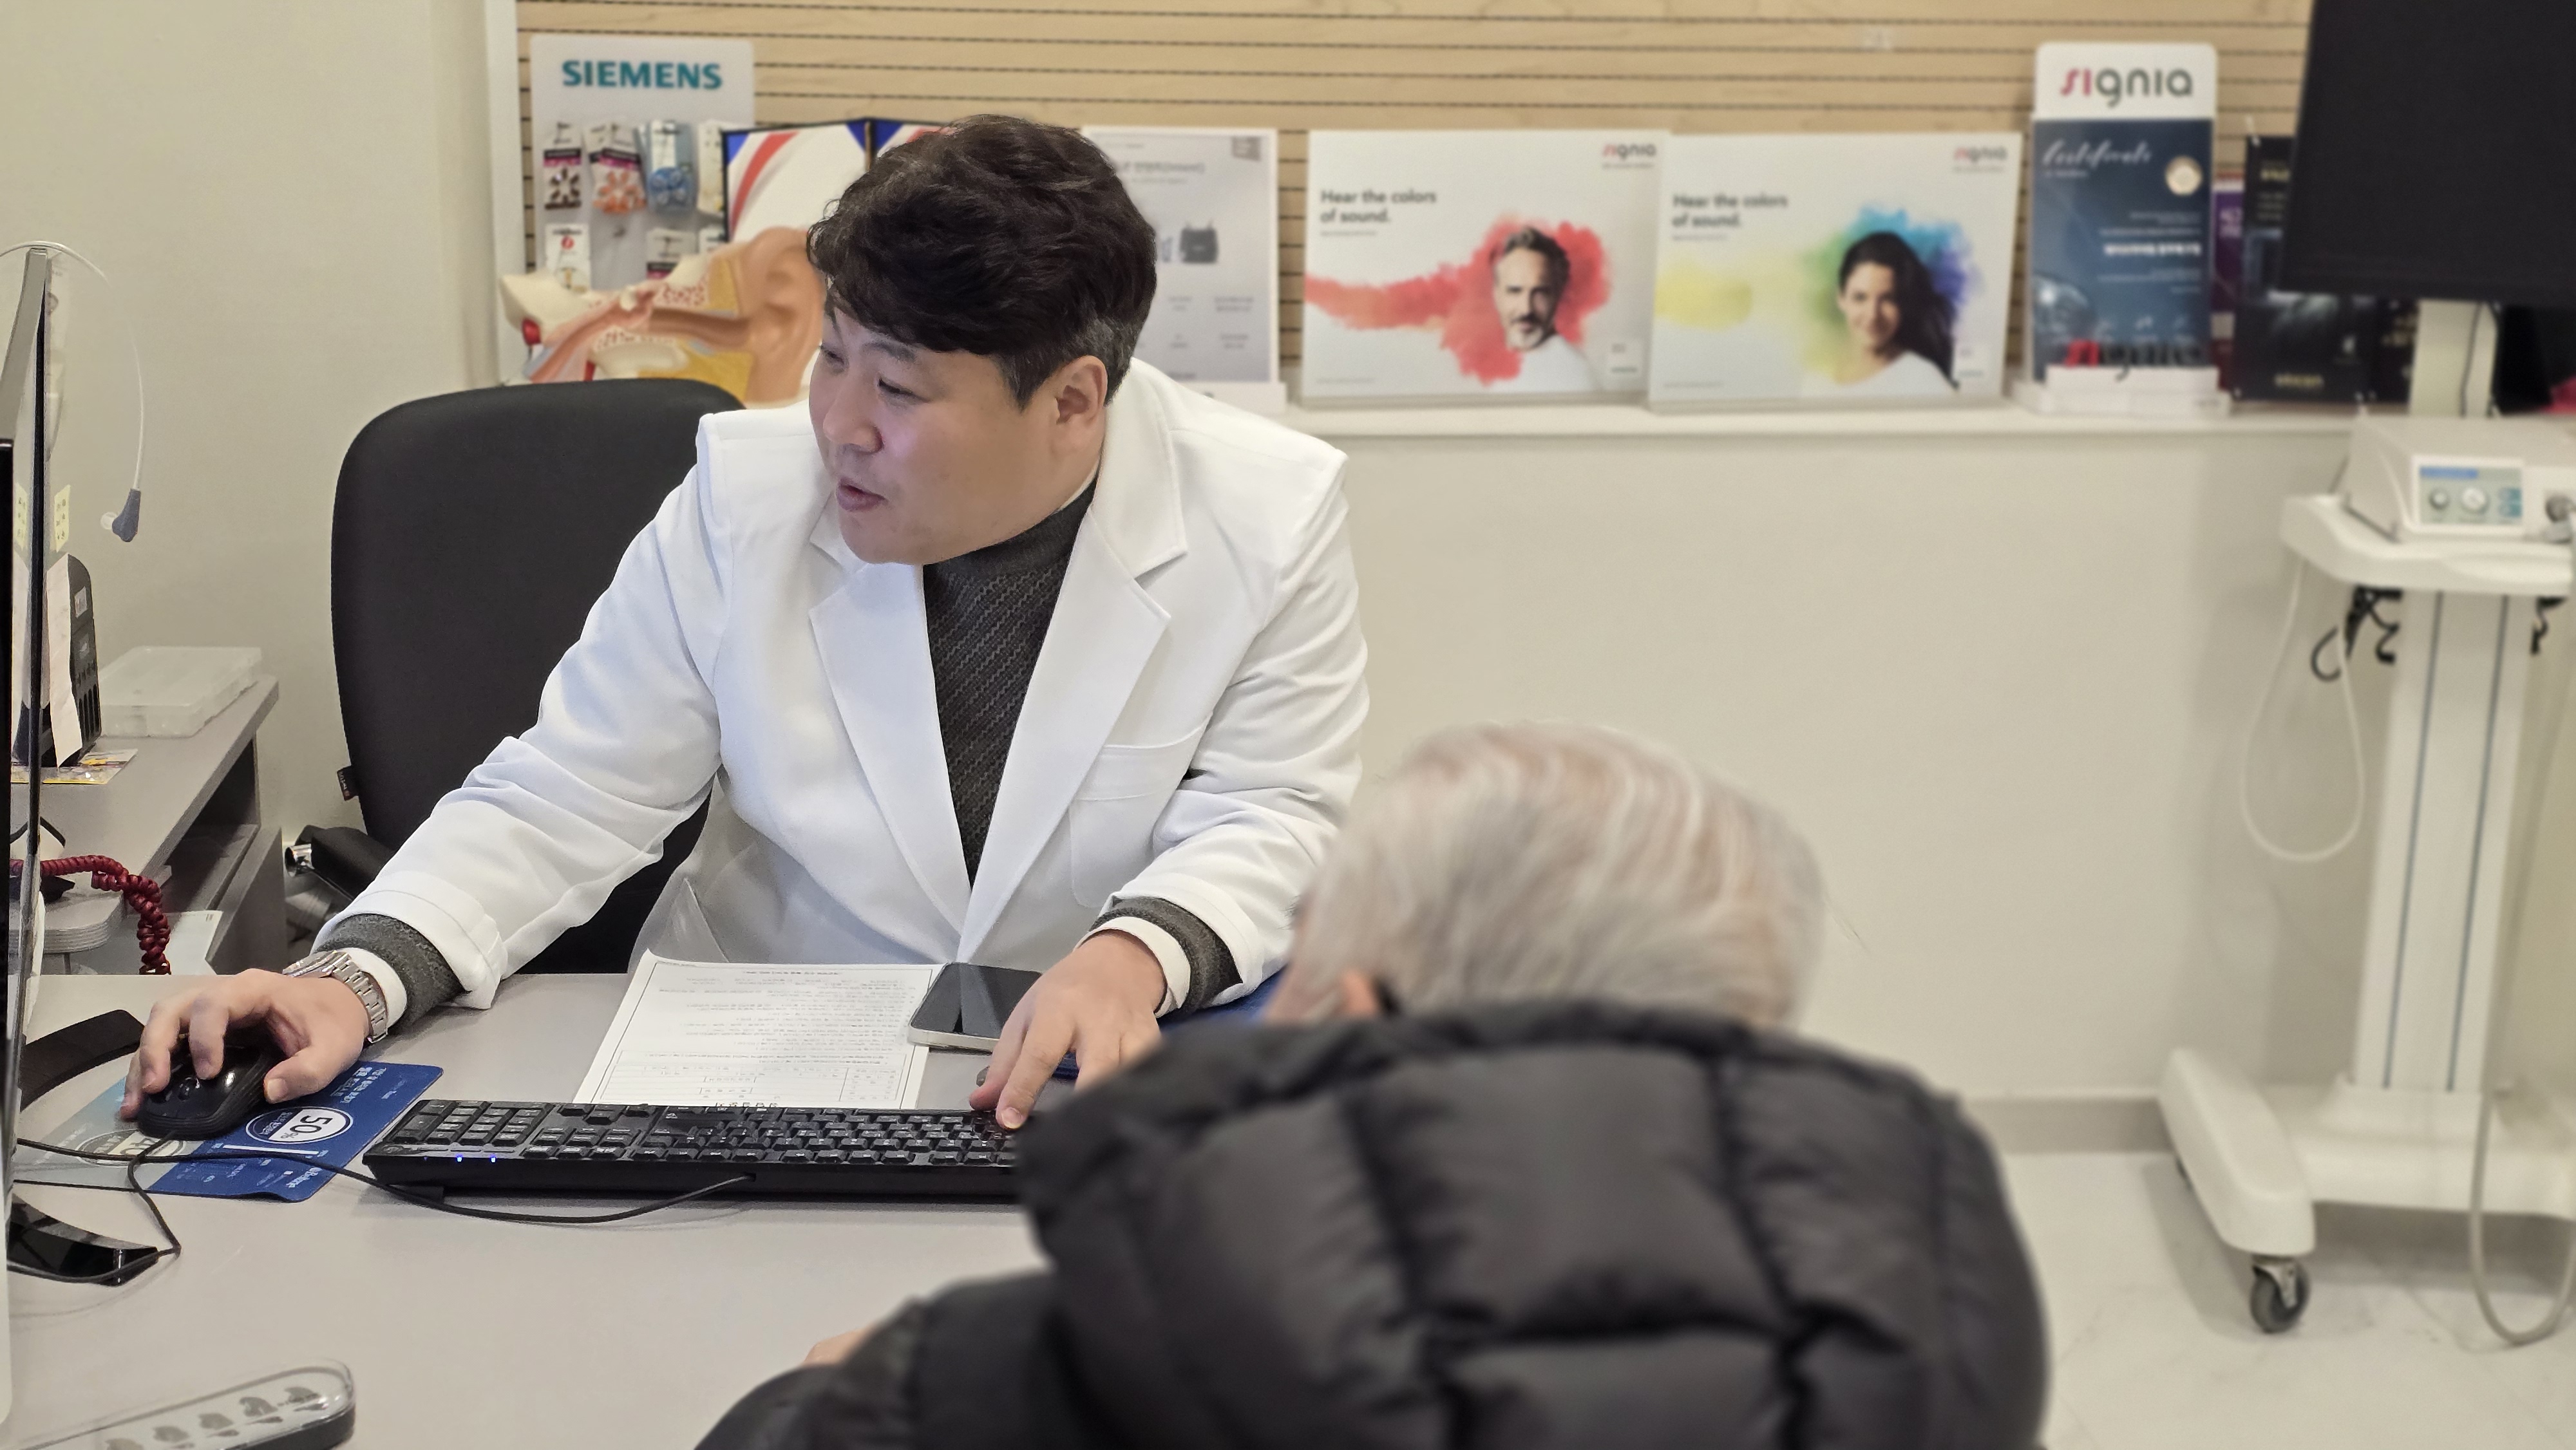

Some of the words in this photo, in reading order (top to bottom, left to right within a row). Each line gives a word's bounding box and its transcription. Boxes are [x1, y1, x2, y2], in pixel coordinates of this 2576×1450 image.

[562, 60, 723, 90] SIEMENS
[2060, 68, 2193, 108] signia
[1603, 144, 1657, 160] signia
[1321, 189, 1356, 203] Hear
[1363, 188, 1386, 202] the
[1392, 188, 1435, 203] colors
[1674, 194, 1709, 208] Hear
[1714, 194, 1738, 207] the
[1743, 194, 1788, 208] colors
[1320, 207, 1336, 222] of
[1340, 208, 1390, 222] sound.
[1672, 213, 1688, 227] of
[1692, 213, 1741, 227] sound.
